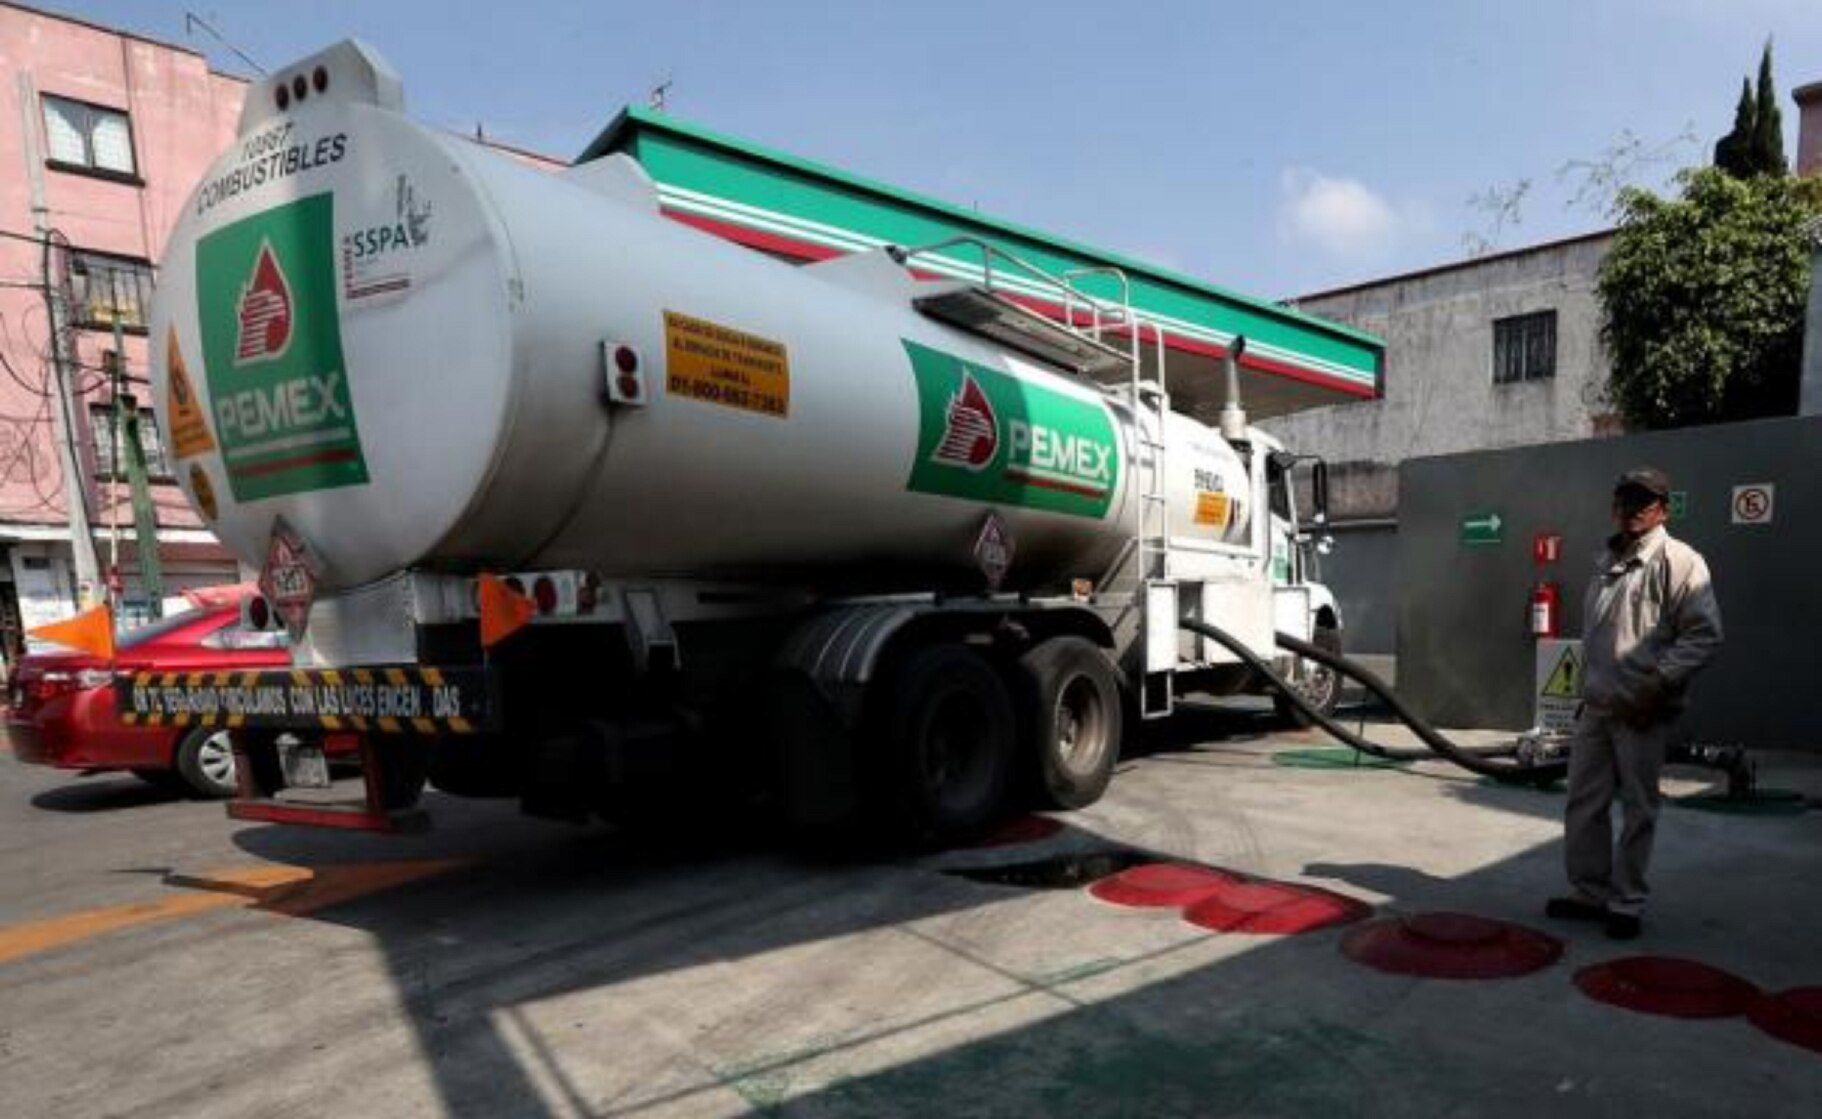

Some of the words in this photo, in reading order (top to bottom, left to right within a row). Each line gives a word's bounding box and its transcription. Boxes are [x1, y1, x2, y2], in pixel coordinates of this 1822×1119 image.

[197, 133, 348, 215] COMBUSTIBLES
[353, 224, 410, 258] SSPA
[216, 371, 345, 443] PEMEX
[1009, 420, 1110, 479] PEMEX
[316, 686, 340, 715] LAS
[340, 686, 375, 716] LUCES
